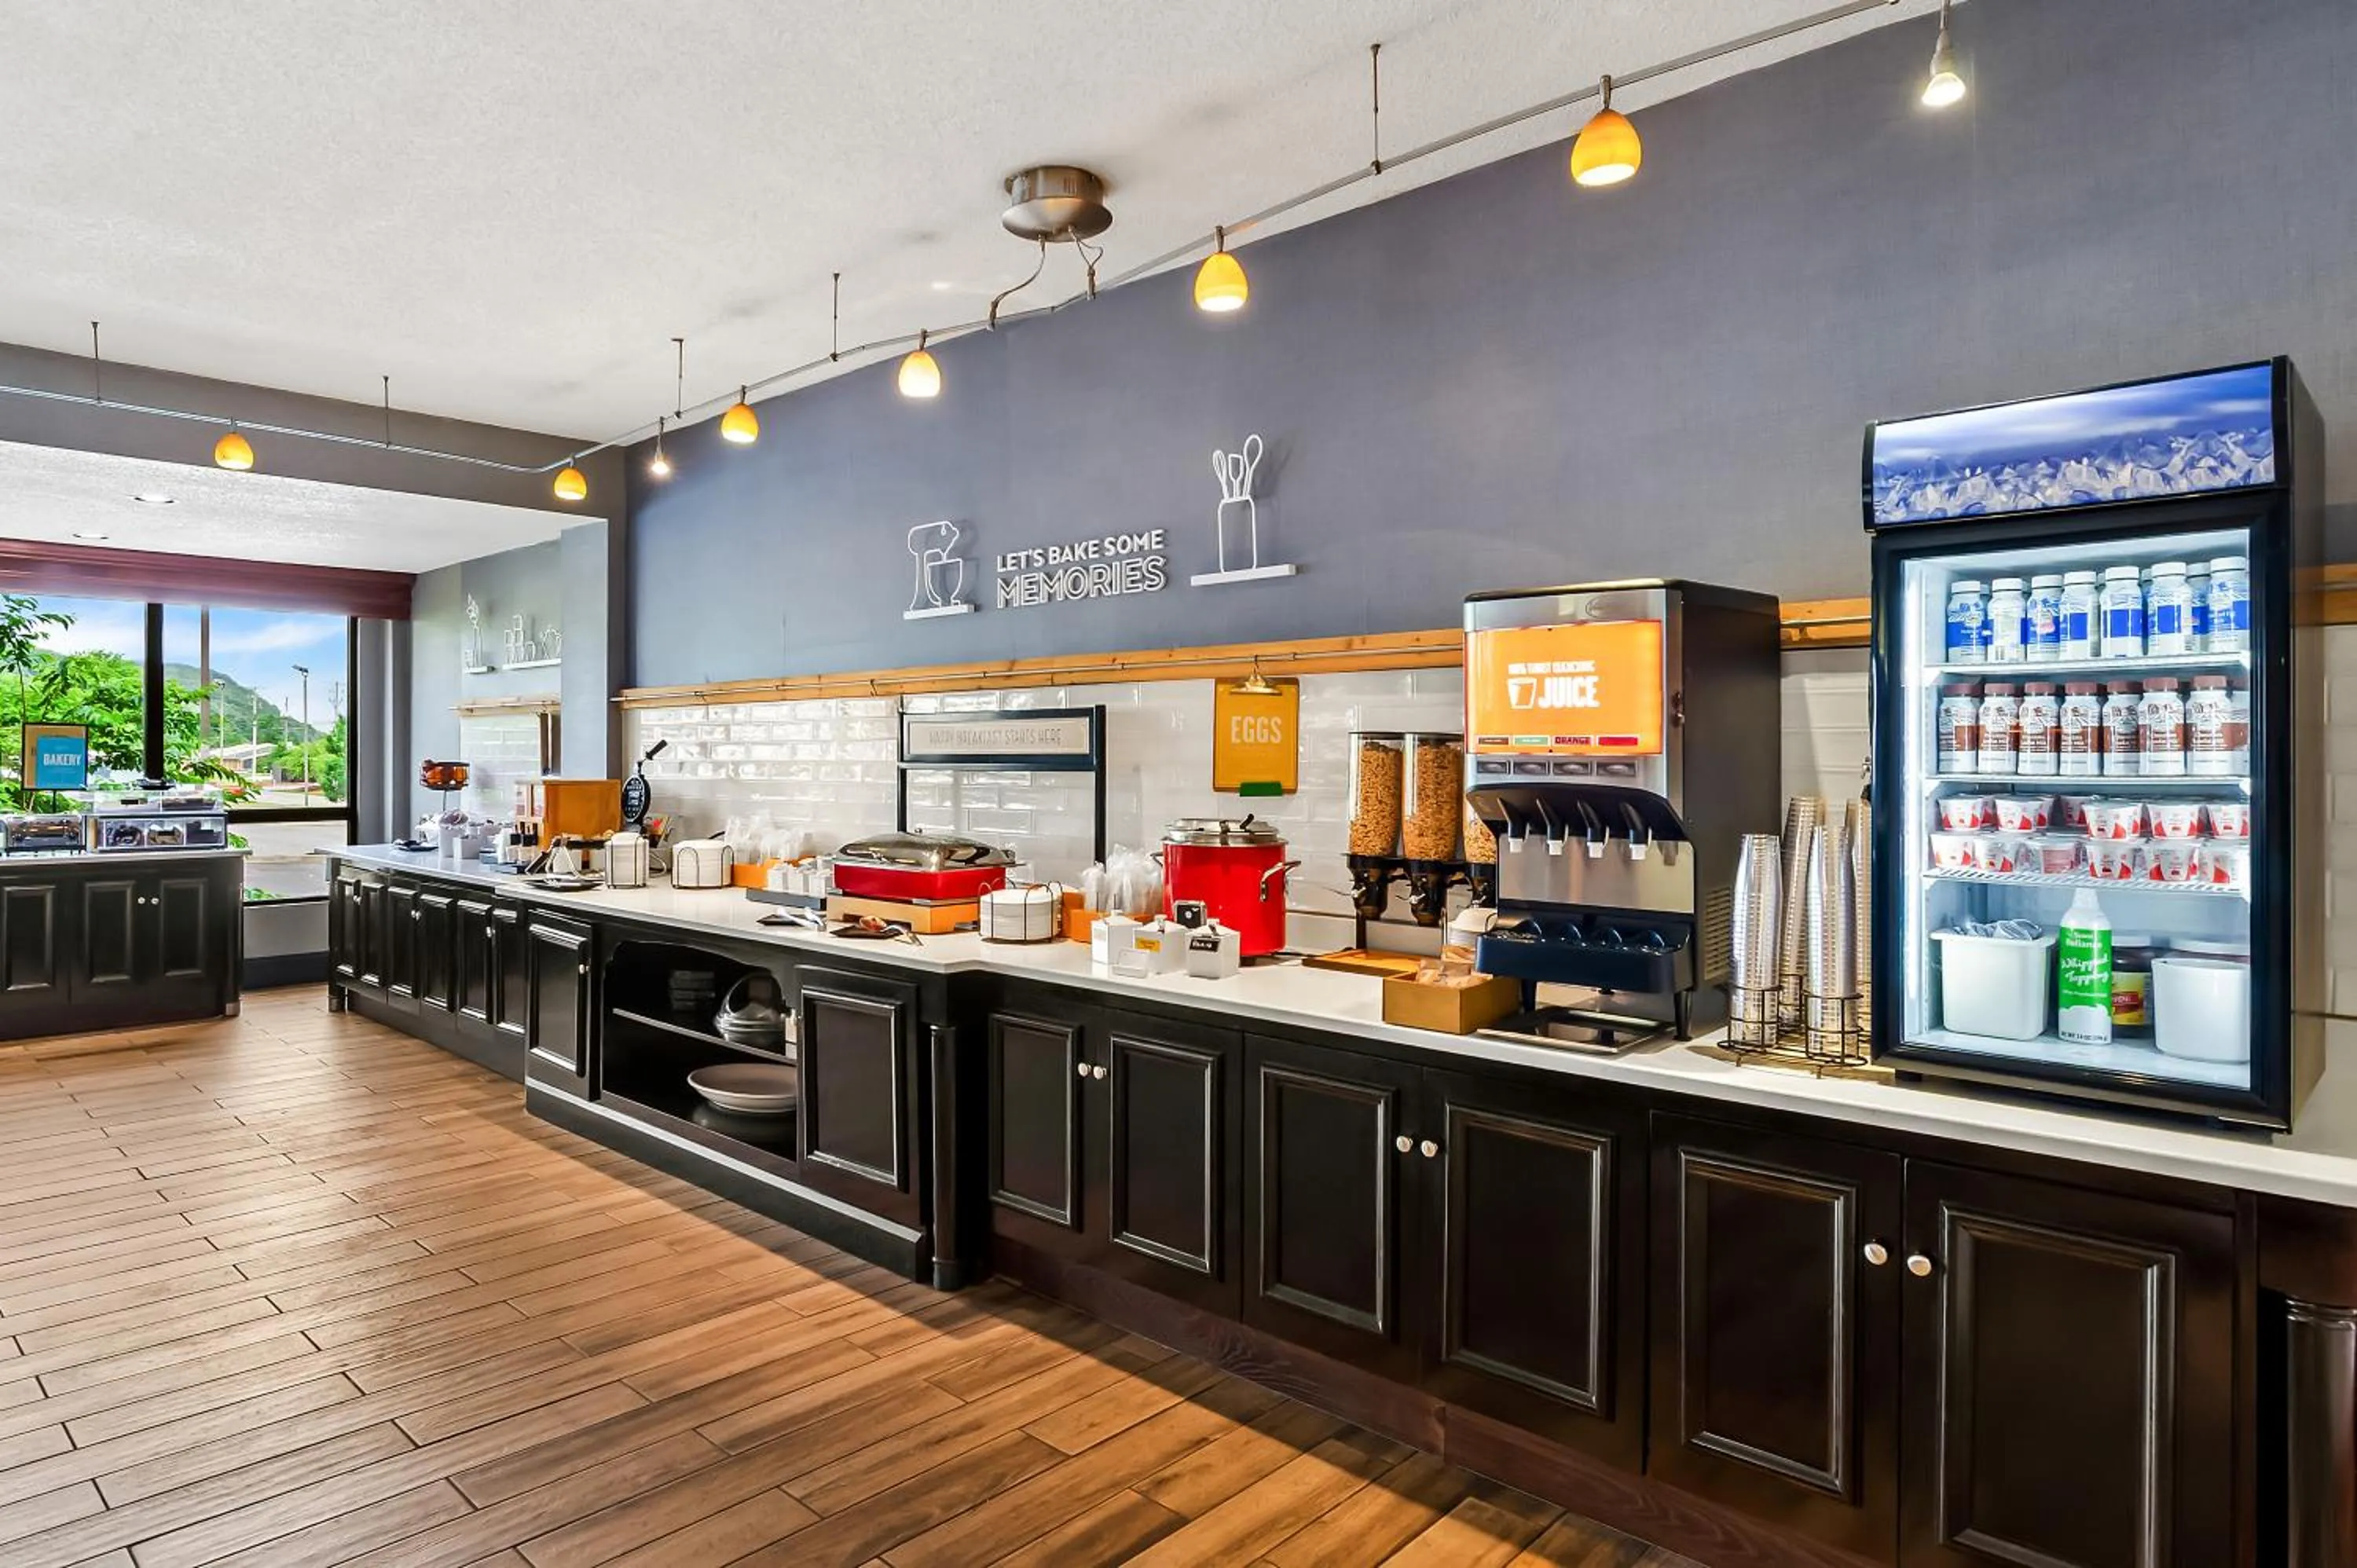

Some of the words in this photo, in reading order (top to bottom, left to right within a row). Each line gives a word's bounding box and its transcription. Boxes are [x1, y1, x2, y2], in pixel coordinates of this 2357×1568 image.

[997, 549, 1045, 573] LET'S
[1049, 540, 1099, 565] BAKE
[1104, 529, 1164, 556] SOME
[997, 555, 1167, 609] MEMORIES
[1538, 676, 1600, 709] JUICE
[1230, 716, 1282, 744] EGGS
[1555, 737, 1591, 746] ORANGE
[43, 753, 82, 767] BAKERY
